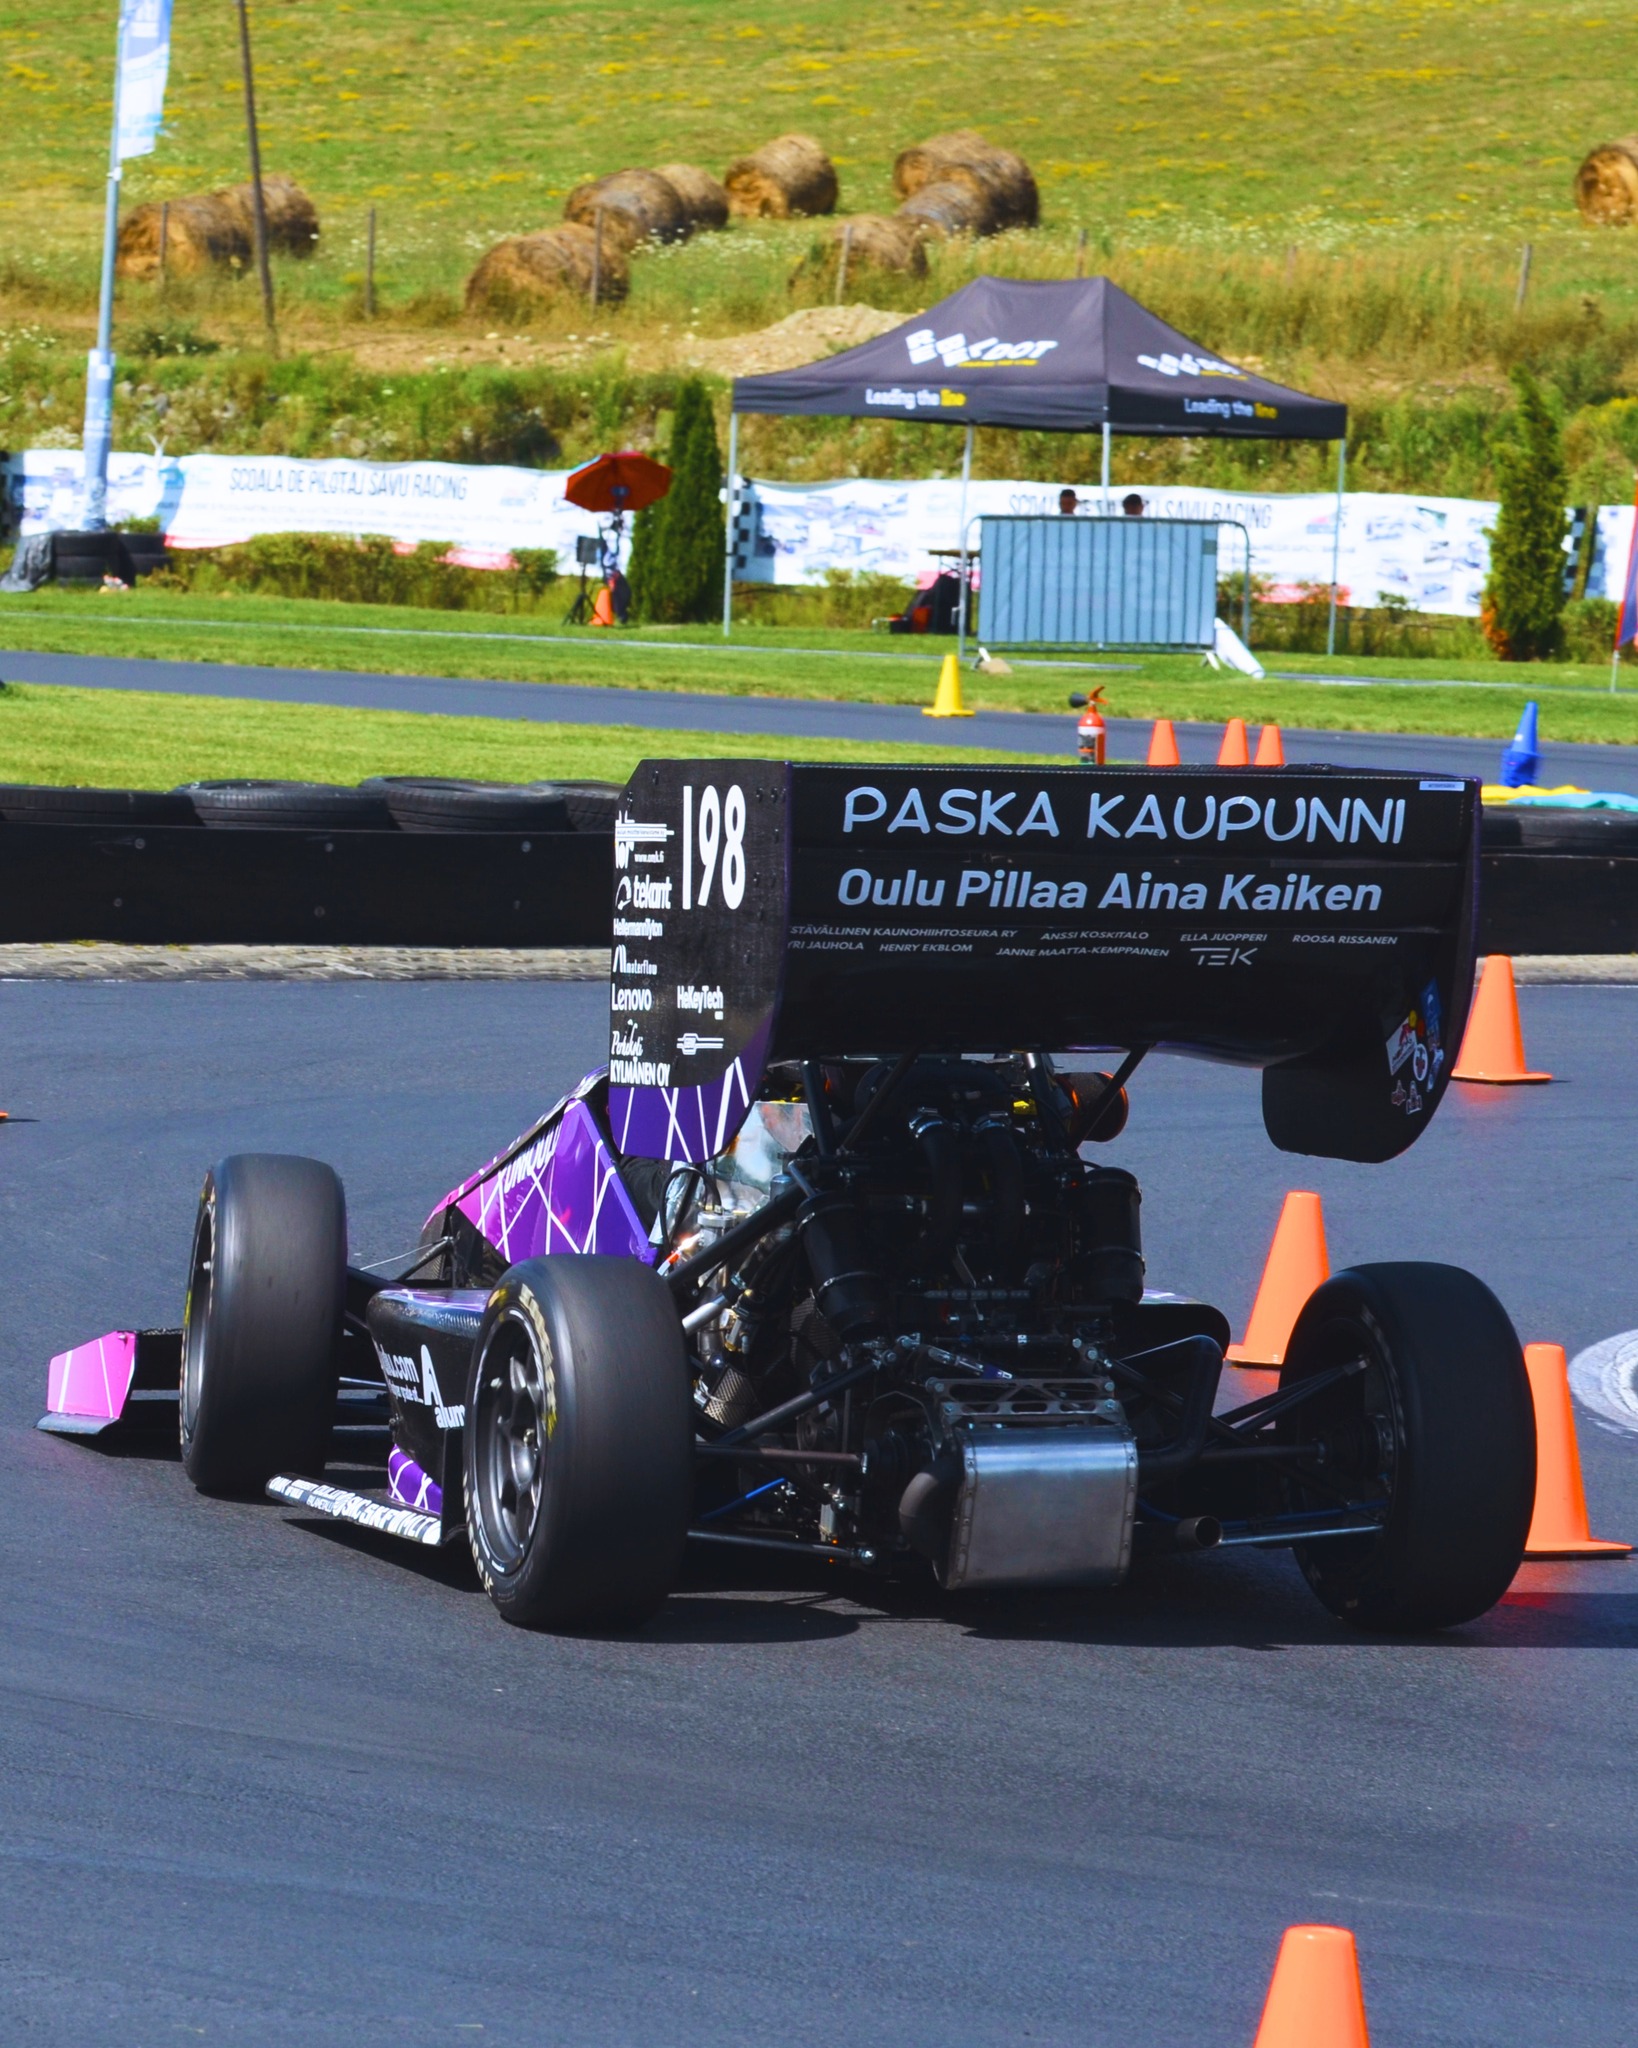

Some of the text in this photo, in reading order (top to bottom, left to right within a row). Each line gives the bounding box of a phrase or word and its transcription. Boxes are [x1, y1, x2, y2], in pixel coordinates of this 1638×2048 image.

[865, 388, 967, 410] Leading the line
[1184, 398, 1278, 419] Leading the line
[287, 469, 305, 493] DE
[308, 470, 363, 495] PILOTAJ
[368, 471, 409, 497] SAVU
[414, 473, 468, 500] RACING
[843, 786, 1406, 844] PASKA KAUPUNNI
[682, 784, 746, 910] 198
[633, 874, 673, 910] tekant
[837, 868, 1382, 911] Oulu Pillaa Aina Kaiken
[789, 923, 1399, 945] STÄVÄLLINEN KAUNOHIIHTOSEURA RY ANSSI KOSKITALO ELLA JUOPPERI ROOSA RISSANEN
[806, 941, 865, 951] JAUHOLA
[879, 943, 921, 953] HENRY
[921, 943, 973, 953] EKBLOM
[996, 948, 1037, 957] JANNE
[611, 983, 653, 1011] Lenovo
[677, 985, 724, 1014] HeKeyTech
[656, 1062, 671, 1087] OY
